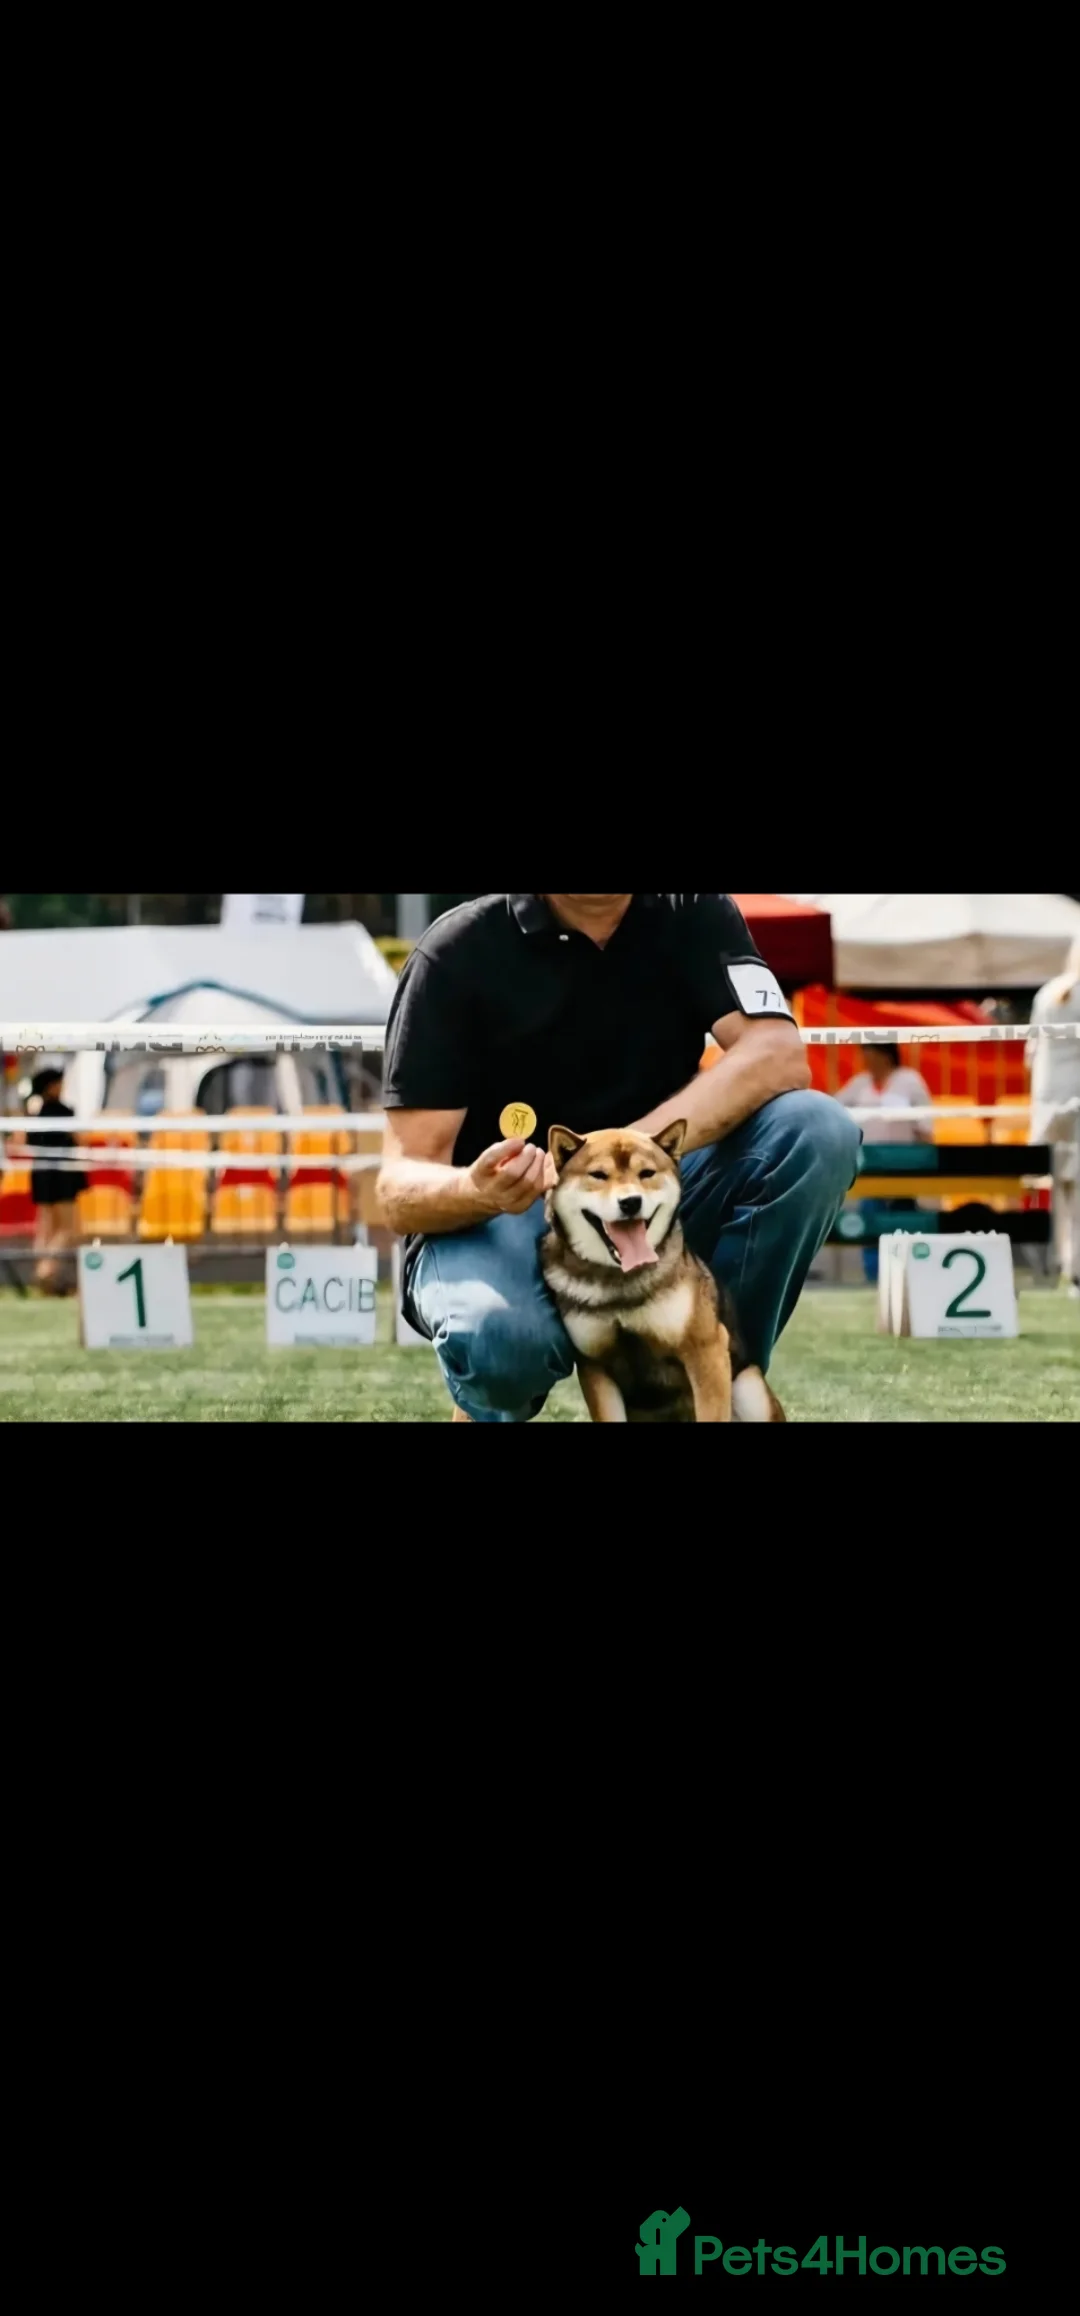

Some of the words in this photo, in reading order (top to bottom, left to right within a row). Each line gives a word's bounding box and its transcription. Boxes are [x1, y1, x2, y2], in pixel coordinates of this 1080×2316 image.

[116, 1257, 146, 1328] 1
[275, 1276, 377, 1314] CACIB
[942, 1248, 992, 1318] 2
